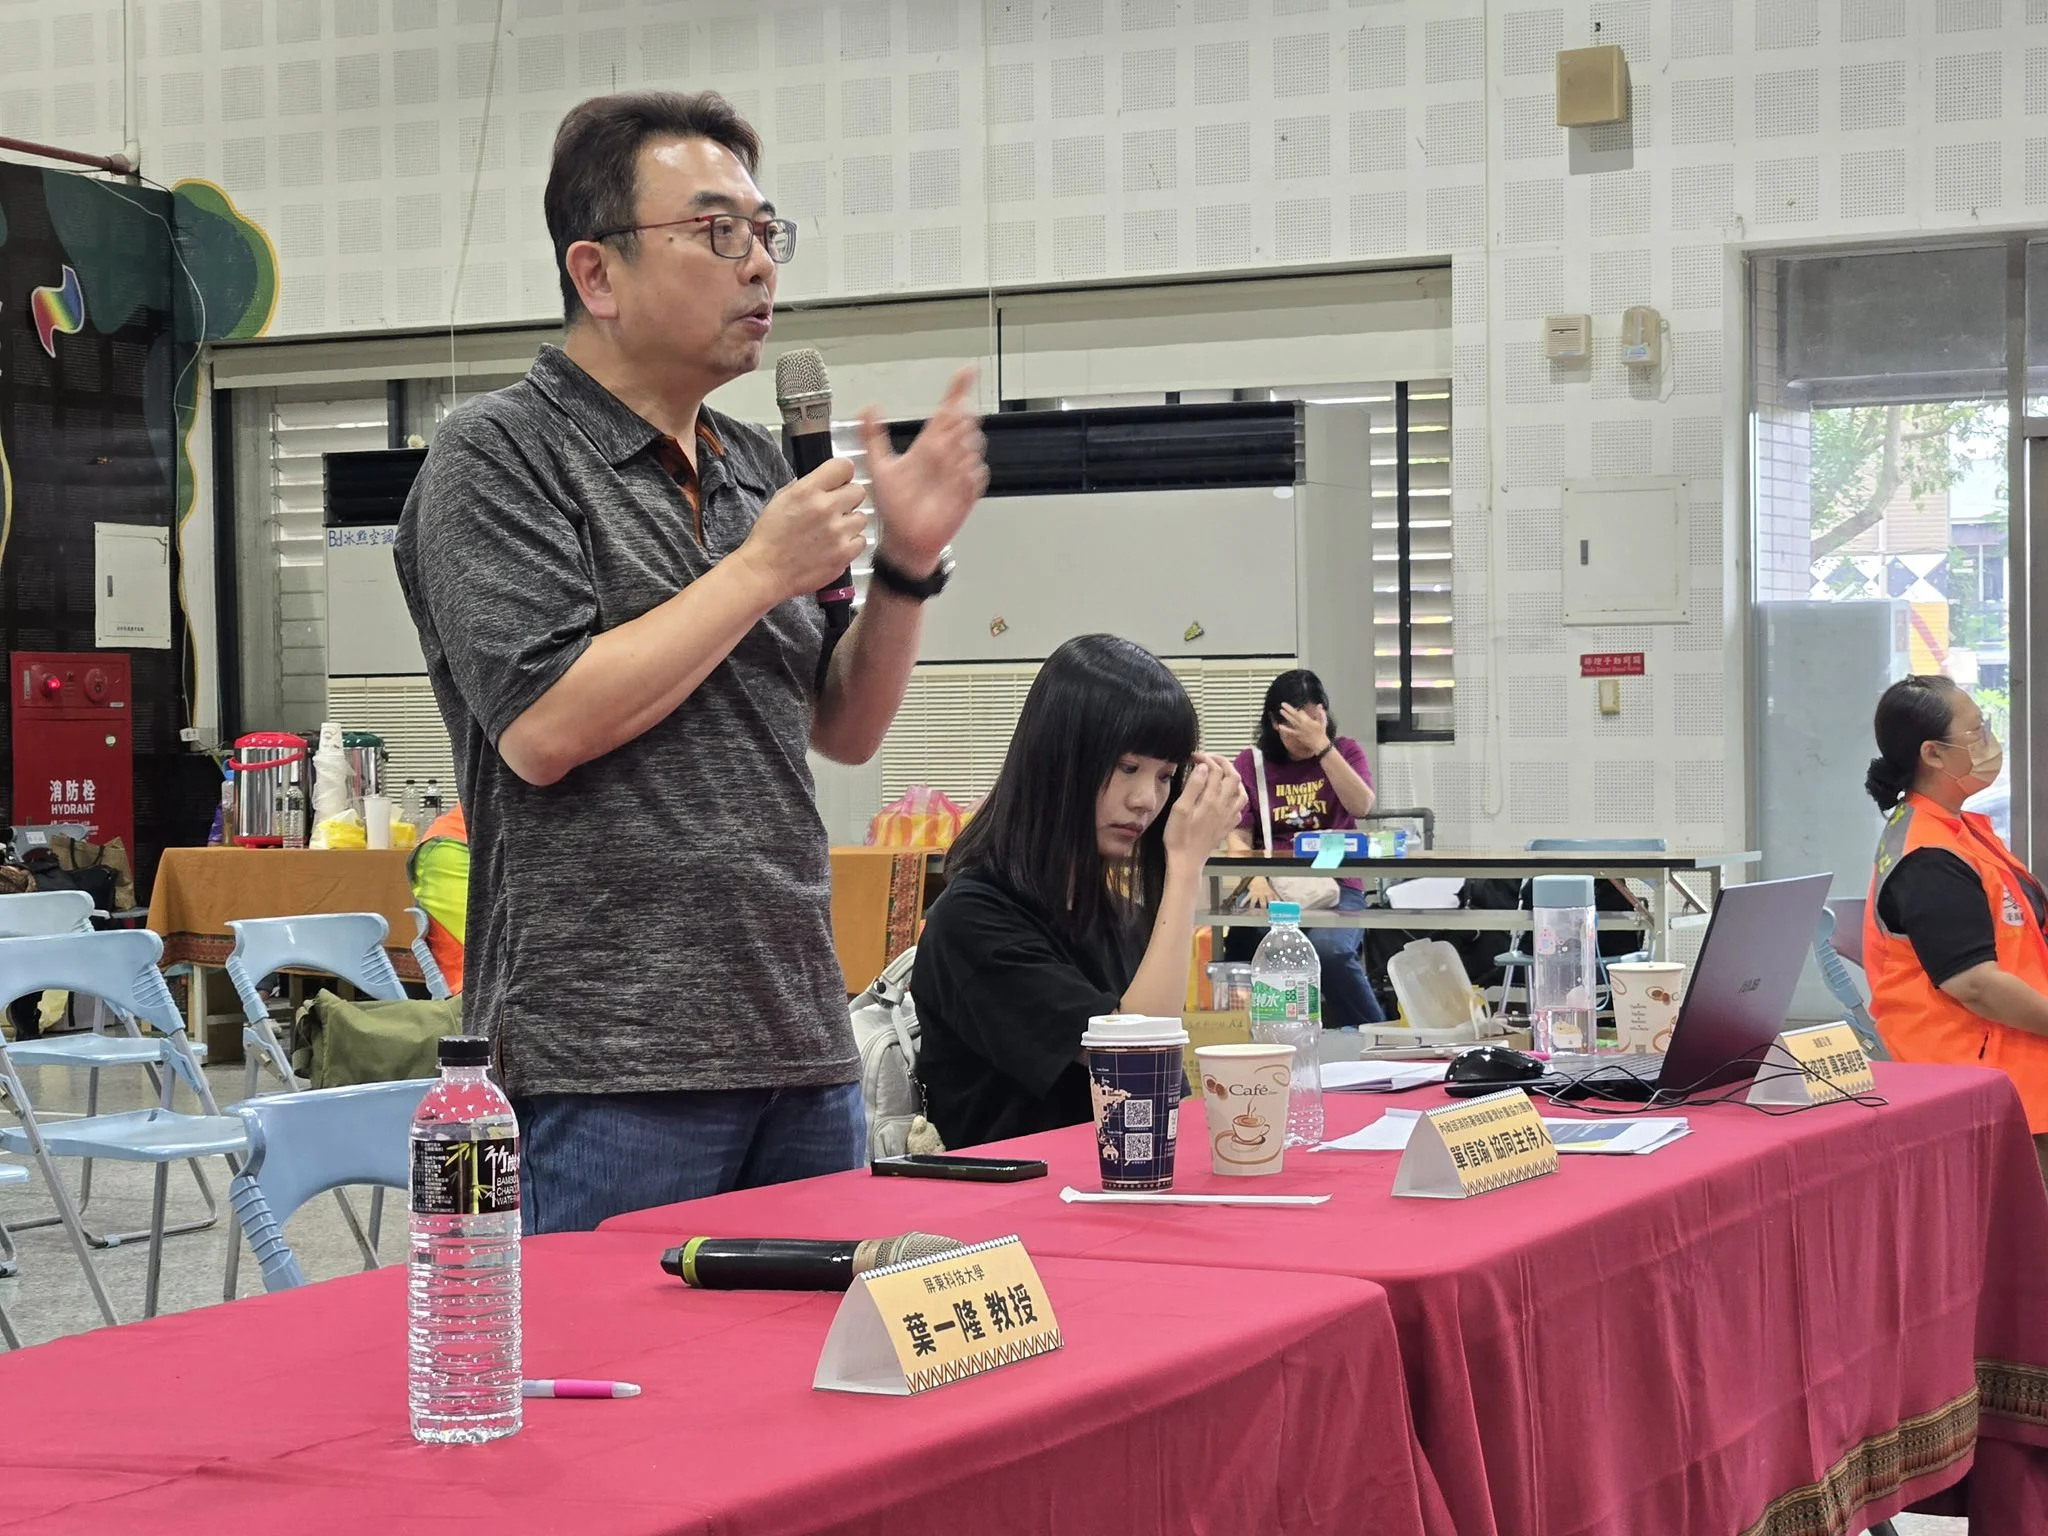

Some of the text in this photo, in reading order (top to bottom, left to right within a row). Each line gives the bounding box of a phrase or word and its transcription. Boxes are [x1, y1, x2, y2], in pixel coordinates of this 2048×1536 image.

[49, 778, 96, 802] 消防栓
[1275, 778, 1325, 797] HANGING
[50, 803, 96, 815] HYDRANT
[1229, 1083, 1269, 1097] Café
[1450, 1138, 1493, 1171] 單信瑜
[1489, 1122, 1553, 1161] 協同主持人
[922, 1264, 986, 1294] 屏東科技大學
[903, 1283, 1038, 1357] 葉一隆 教授
